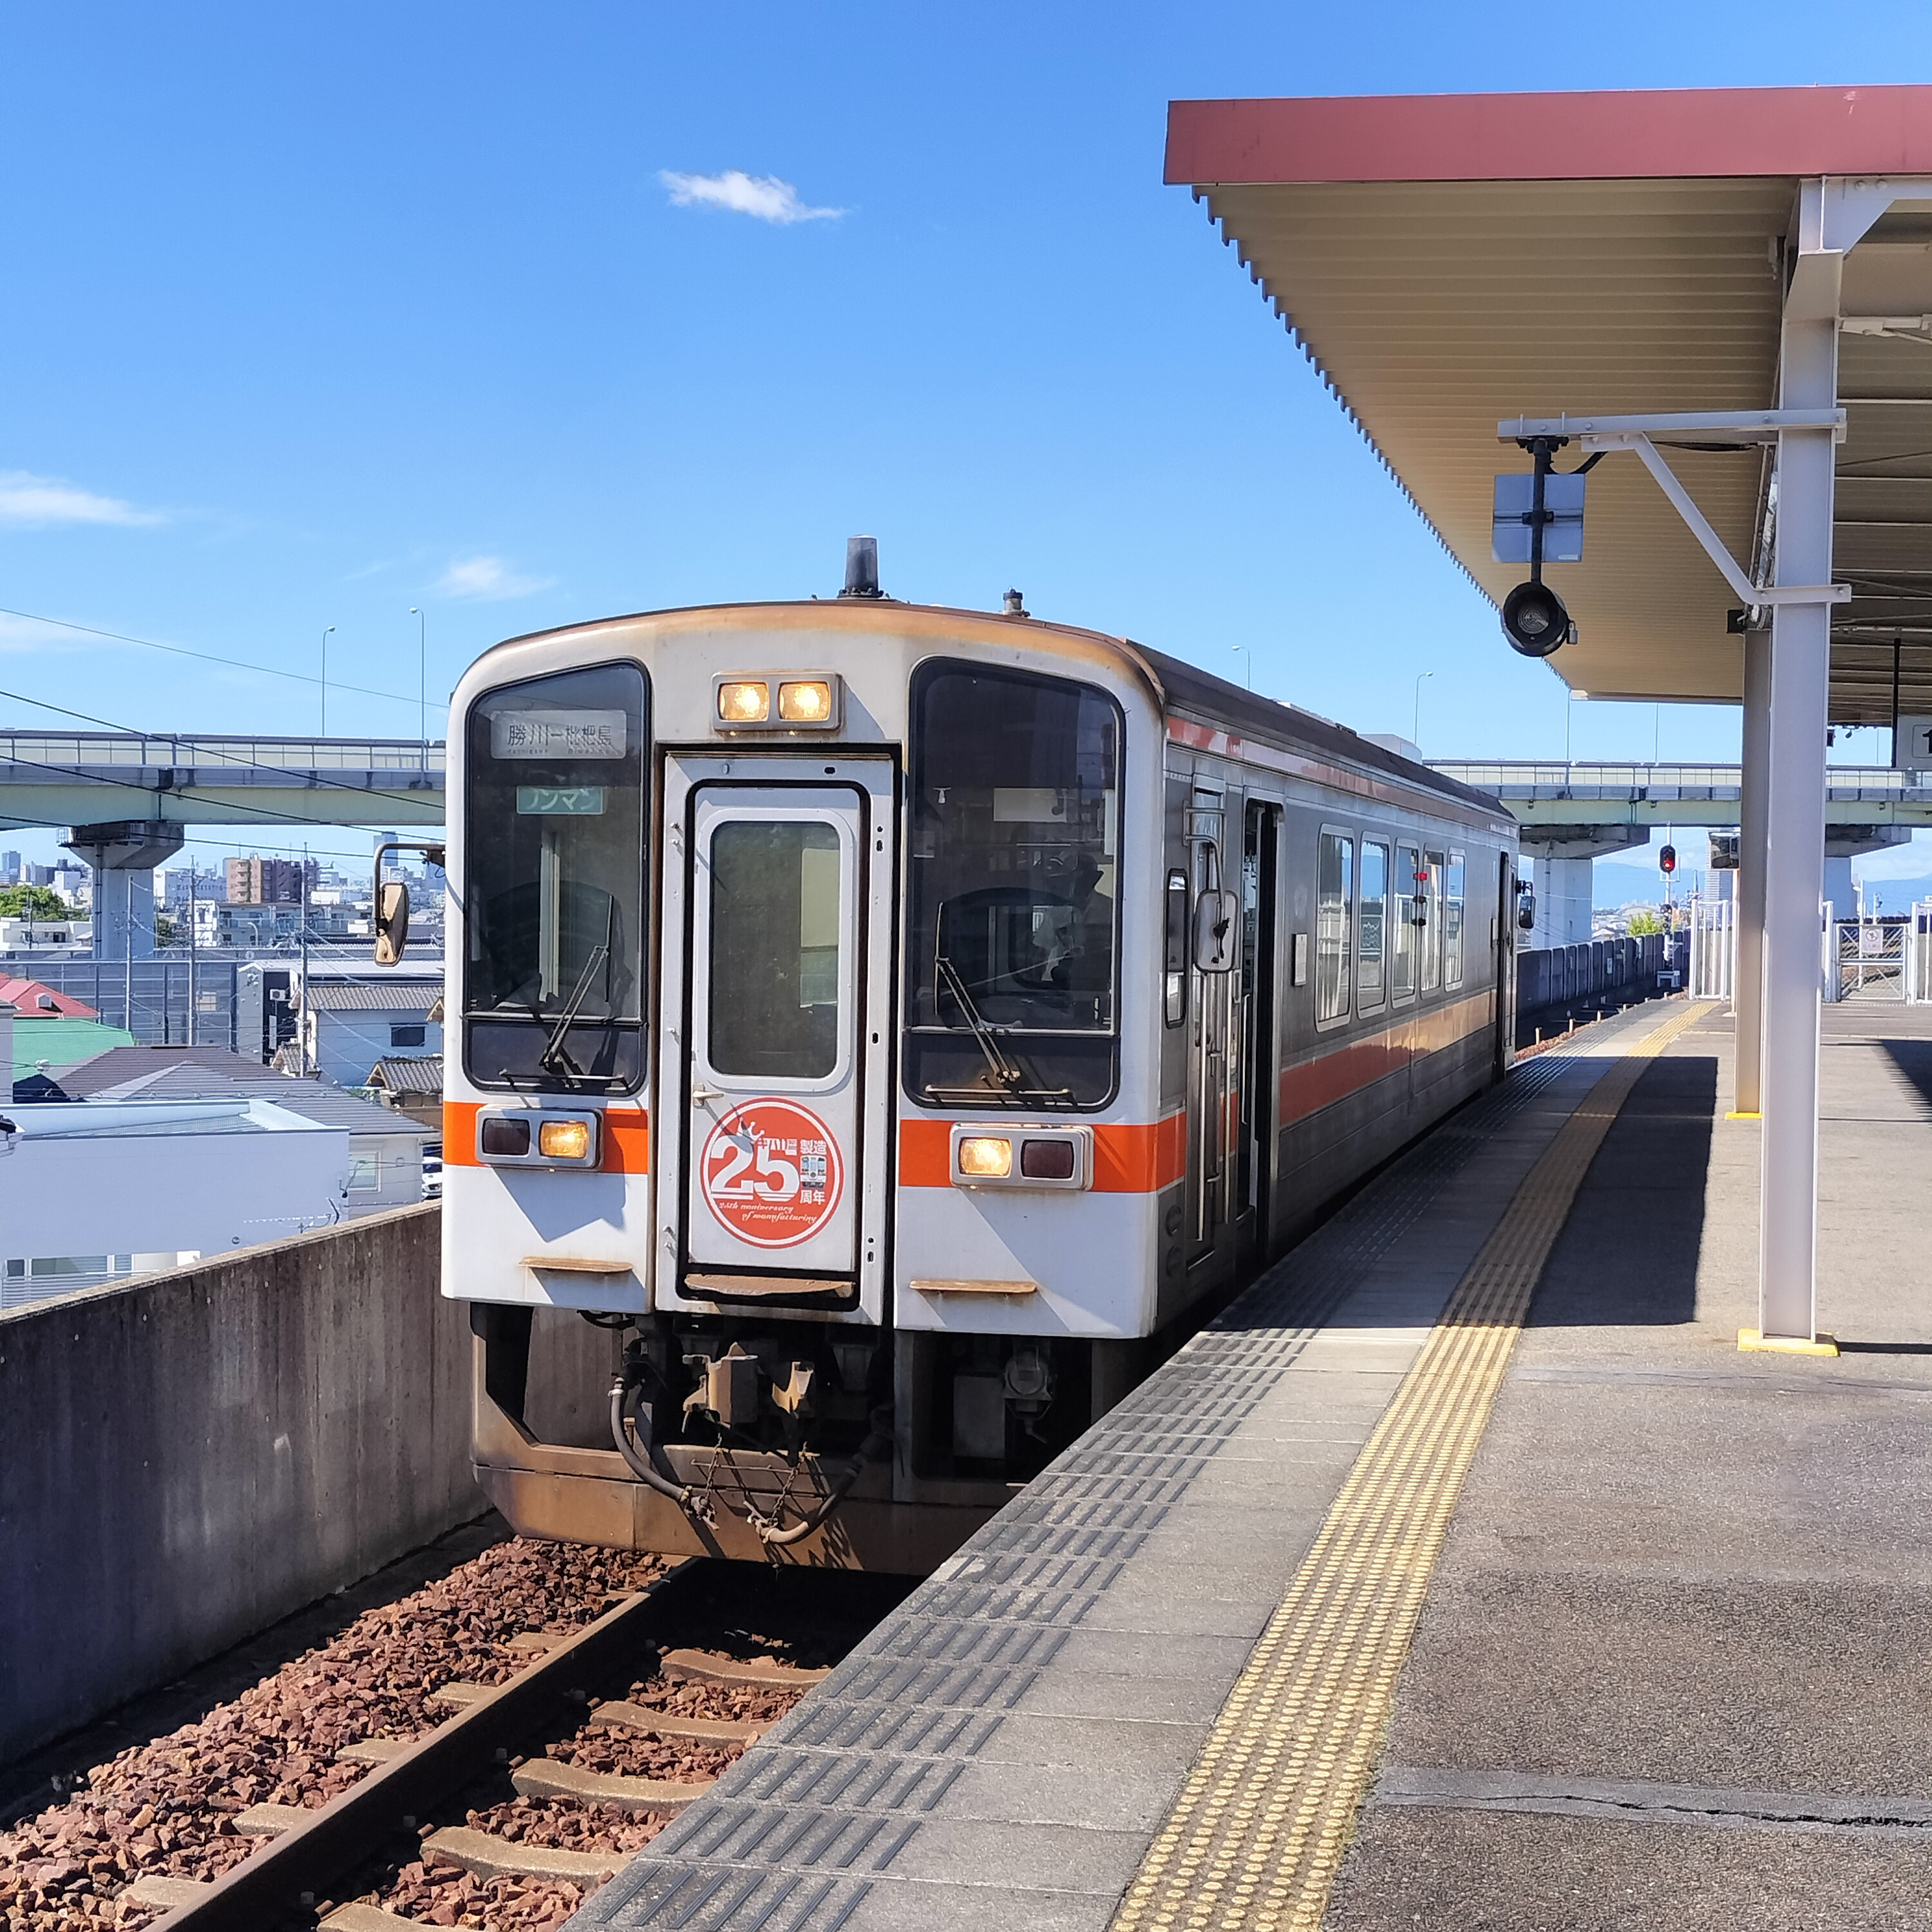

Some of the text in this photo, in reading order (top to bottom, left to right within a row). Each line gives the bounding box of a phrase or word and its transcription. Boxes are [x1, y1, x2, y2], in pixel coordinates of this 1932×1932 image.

[800, 1139, 826, 1155] 製造
[710, 1135, 800, 1202] 25
[800, 1190, 826, 1205] 周年
